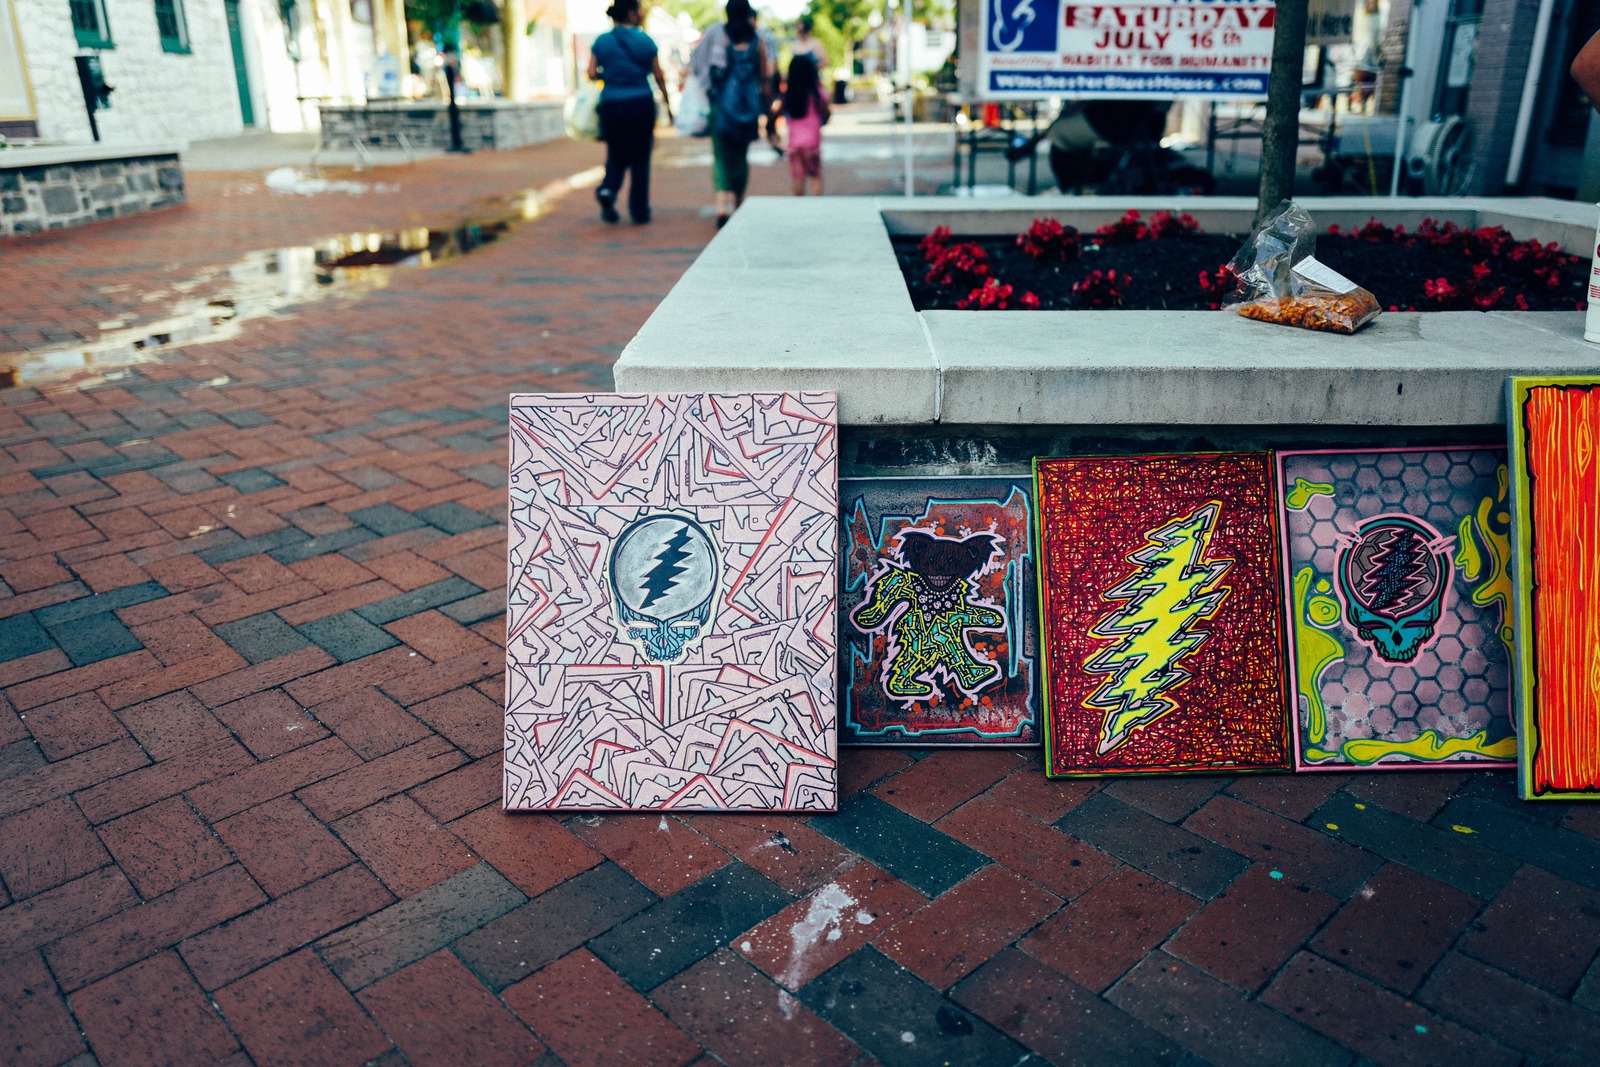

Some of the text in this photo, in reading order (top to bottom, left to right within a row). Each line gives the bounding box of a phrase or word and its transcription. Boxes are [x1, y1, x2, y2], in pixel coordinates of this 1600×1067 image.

[1072, 6, 1268, 29] SATURDAY
[1095, 31, 1169, 49] JULY
[1190, 32, 1213, 48] 16
[1063, 55, 1134, 66] HABITAT
[1142, 55, 1173, 66] FOR
[1180, 56, 1268, 67] HUMANITY
